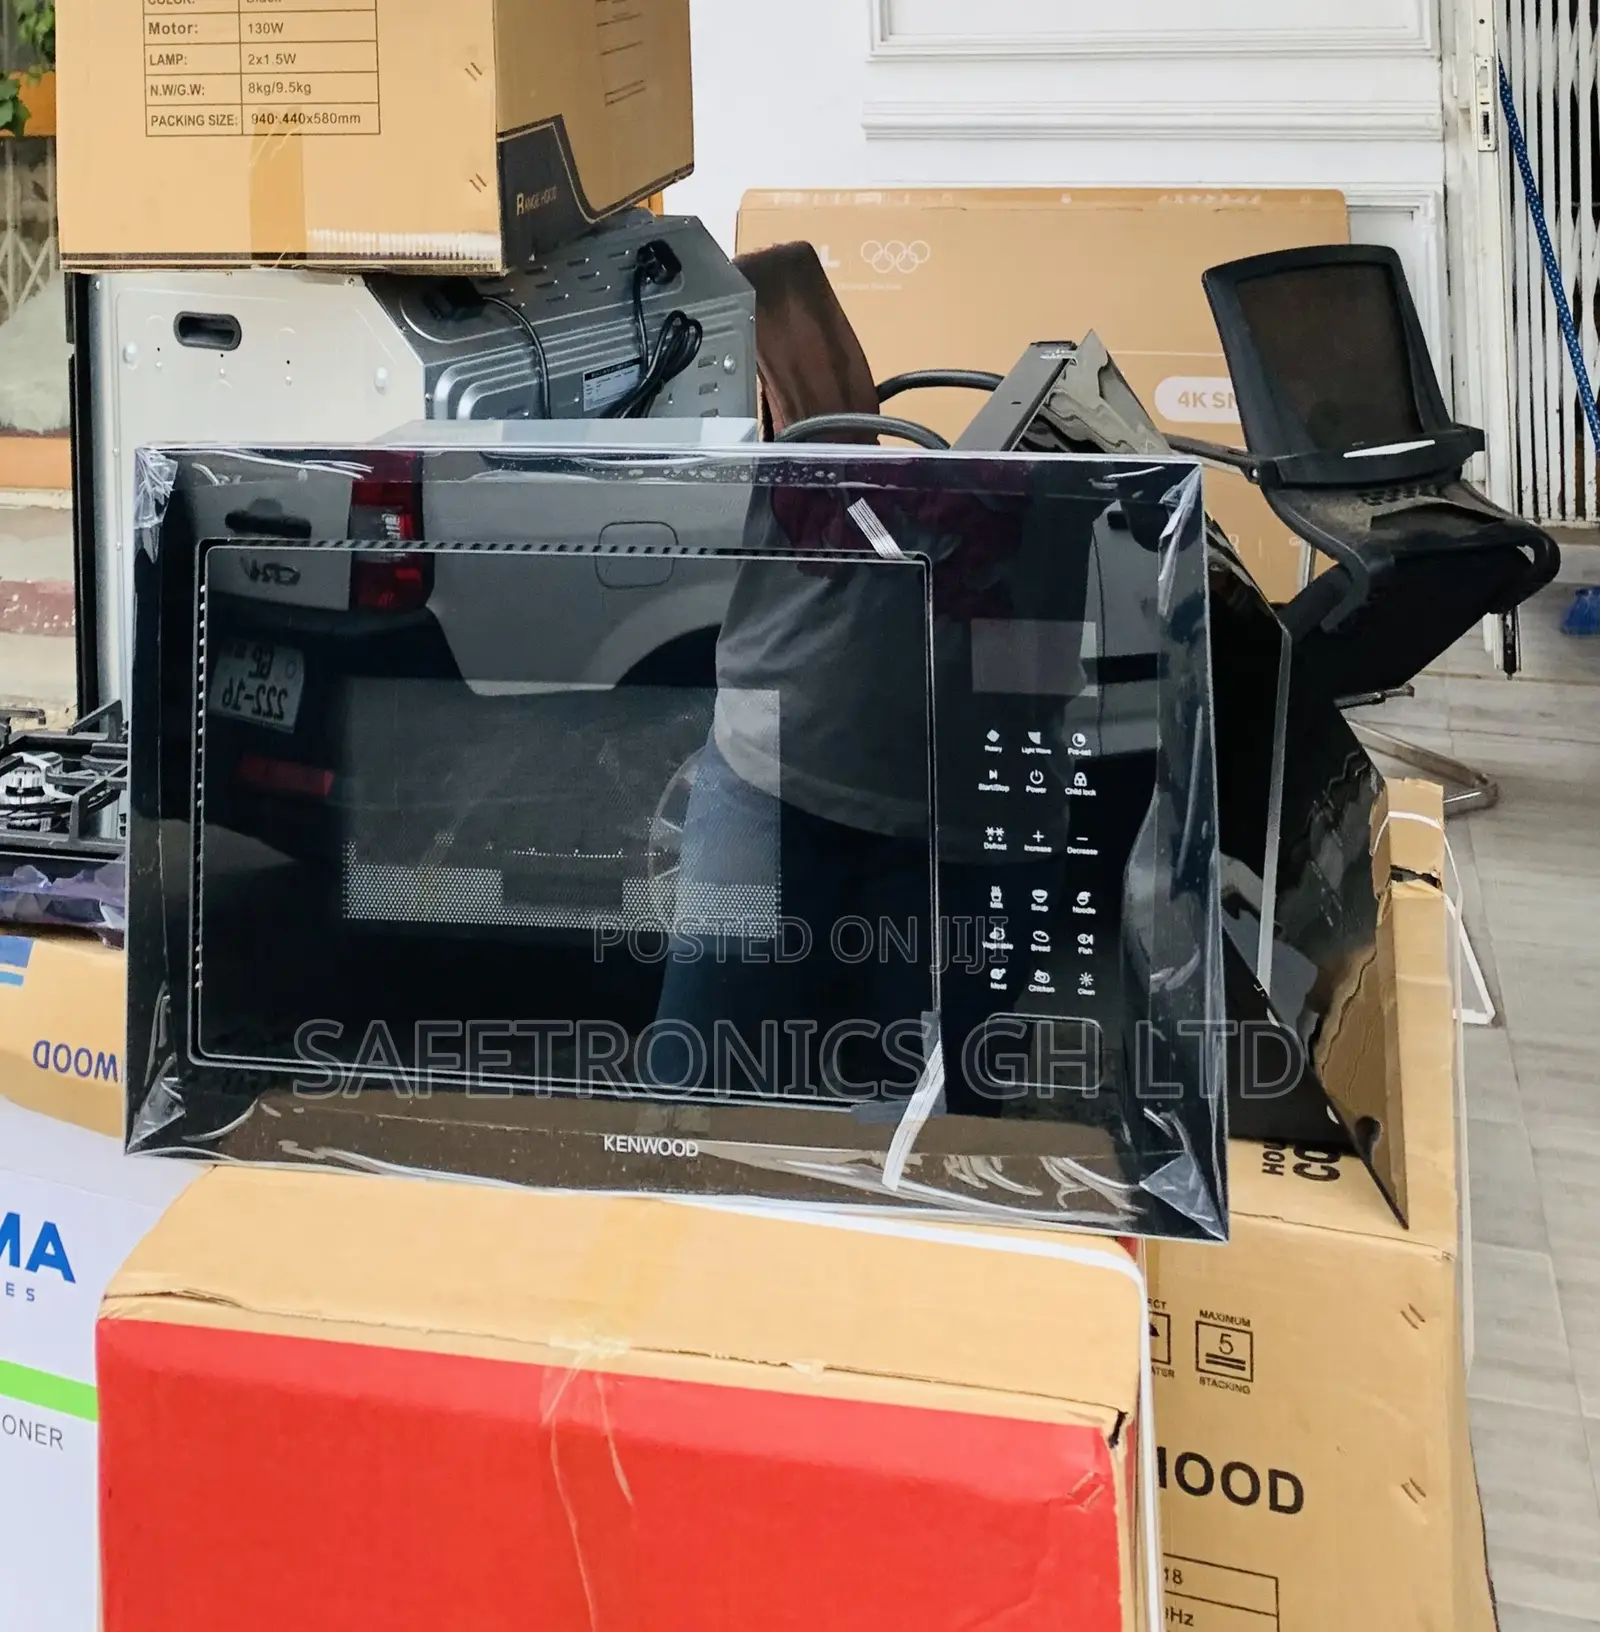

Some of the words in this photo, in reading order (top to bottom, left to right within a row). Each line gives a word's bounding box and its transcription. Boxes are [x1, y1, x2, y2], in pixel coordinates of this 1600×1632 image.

[148, 22, 199, 35] Motor:
[248, 22, 284, 35] 130W
[149, 53, 188, 66] LAMP:
[248, 53, 297, 66] 2x1.5W
[150, 84, 205, 97] N.W/G.W:
[248, 82, 312, 96] 8kg/9.5kg
[151, 114, 205, 127] PACKING
[208, 114, 238, 127] SIZE:
[1178, 391, 1207, 409] 4K
[1025, 785, 1047, 794] Power
[1064, 787, 1082, 797] Child
[1083, 788, 1097, 797] lock
[983, 841, 1007, 851] Defrost
[1024, 844, 1052, 853] Increase
[1067, 846, 1098, 856] Decrease
[1030, 903, 1049, 913] Soup
[1078, 946, 1093, 955] Fish
[1028, 984, 1056, 993] Chicken
[33, 1040, 124, 1083] WOOD
[603, 1134, 700, 1158] KENWOOD
[1199, 1309, 1251, 1328] MAXIMUM
[1218, 1332, 1234, 1355] 5
[1199, 1376, 1251, 1395] STACKING
[2, 1413, 64, 1451] ONER
[1165, 1606, 1194, 1627] Hz
